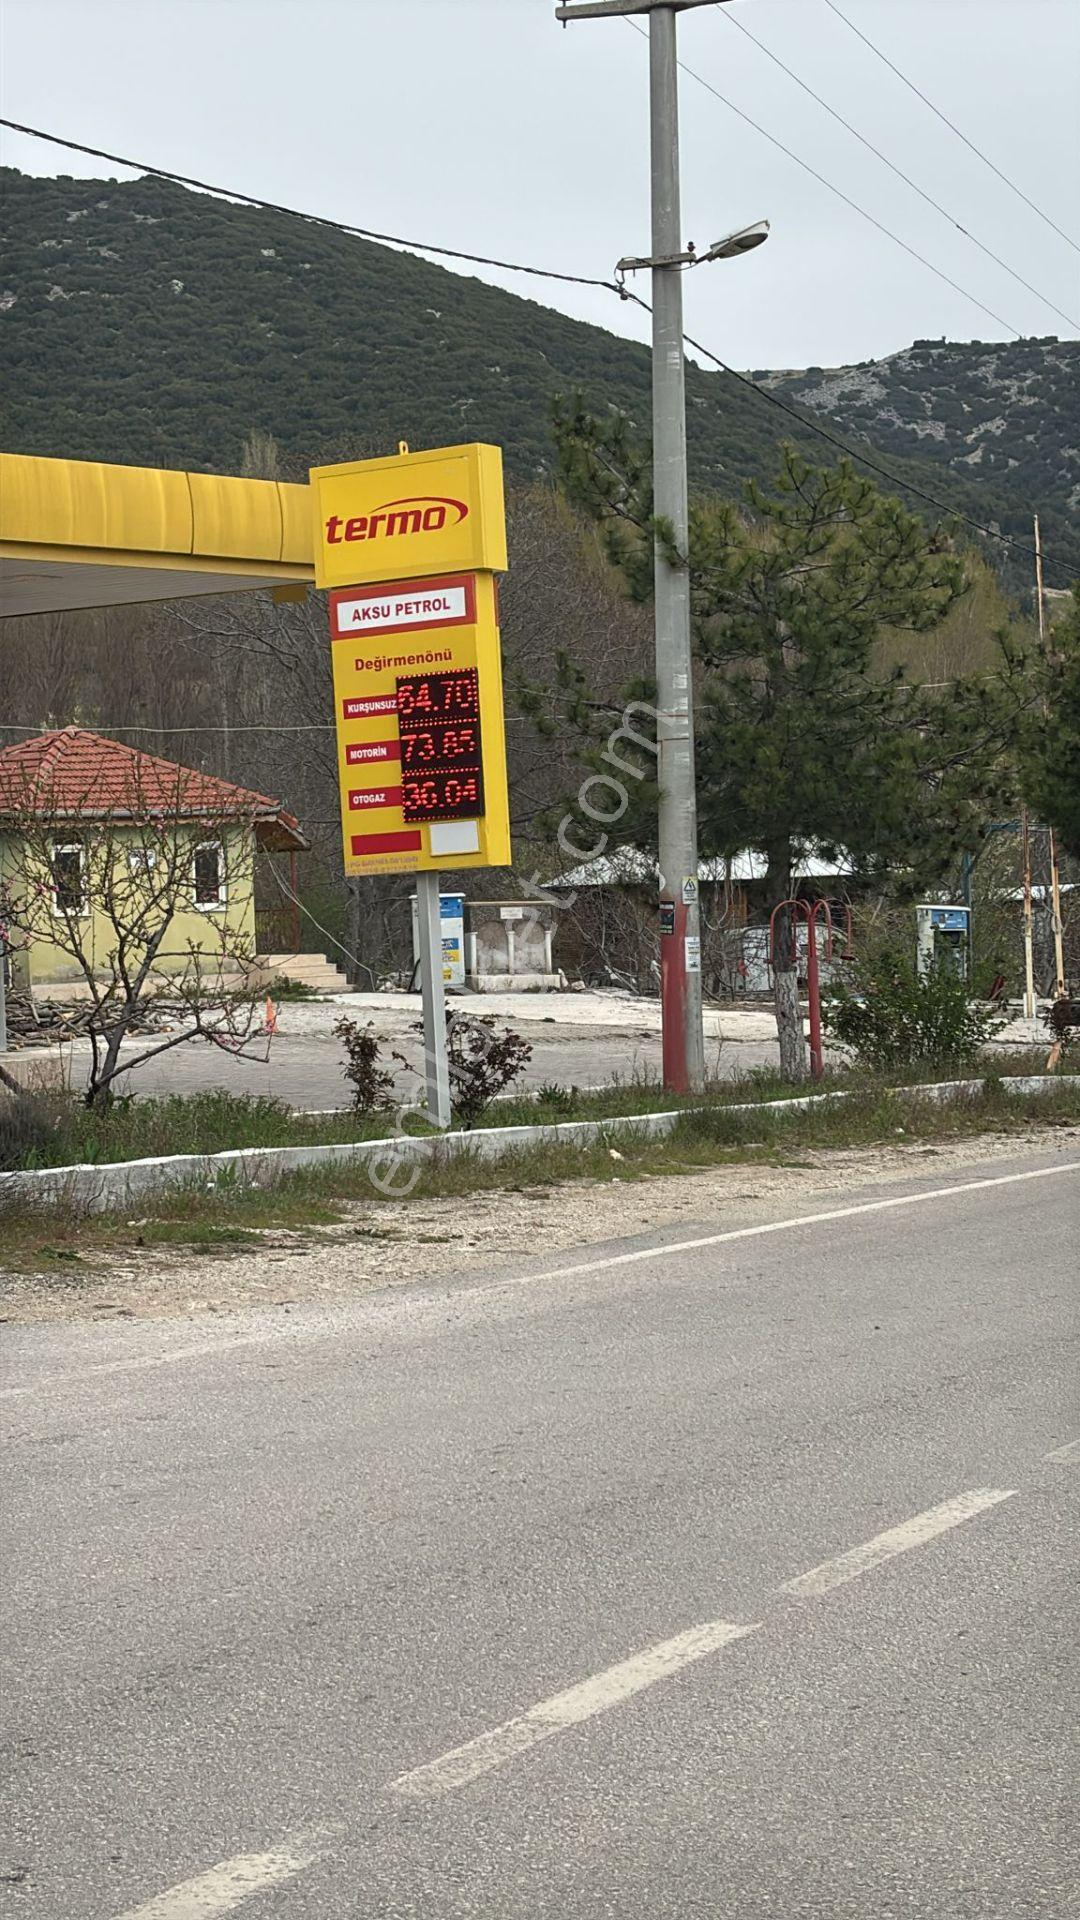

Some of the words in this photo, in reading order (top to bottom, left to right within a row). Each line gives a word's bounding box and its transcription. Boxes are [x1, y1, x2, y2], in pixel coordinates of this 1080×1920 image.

[326, 505, 447, 544] termo
[352, 605, 391, 622] AKSU
[395, 597, 451, 616] PETROL
[355, 649, 452, 671] Değirmenönü
[347, 699, 397, 714] KURŞUNSUZ
[350, 746, 387, 759] MOTORİN
[353, 793, 386, 804] OTOGAZ
